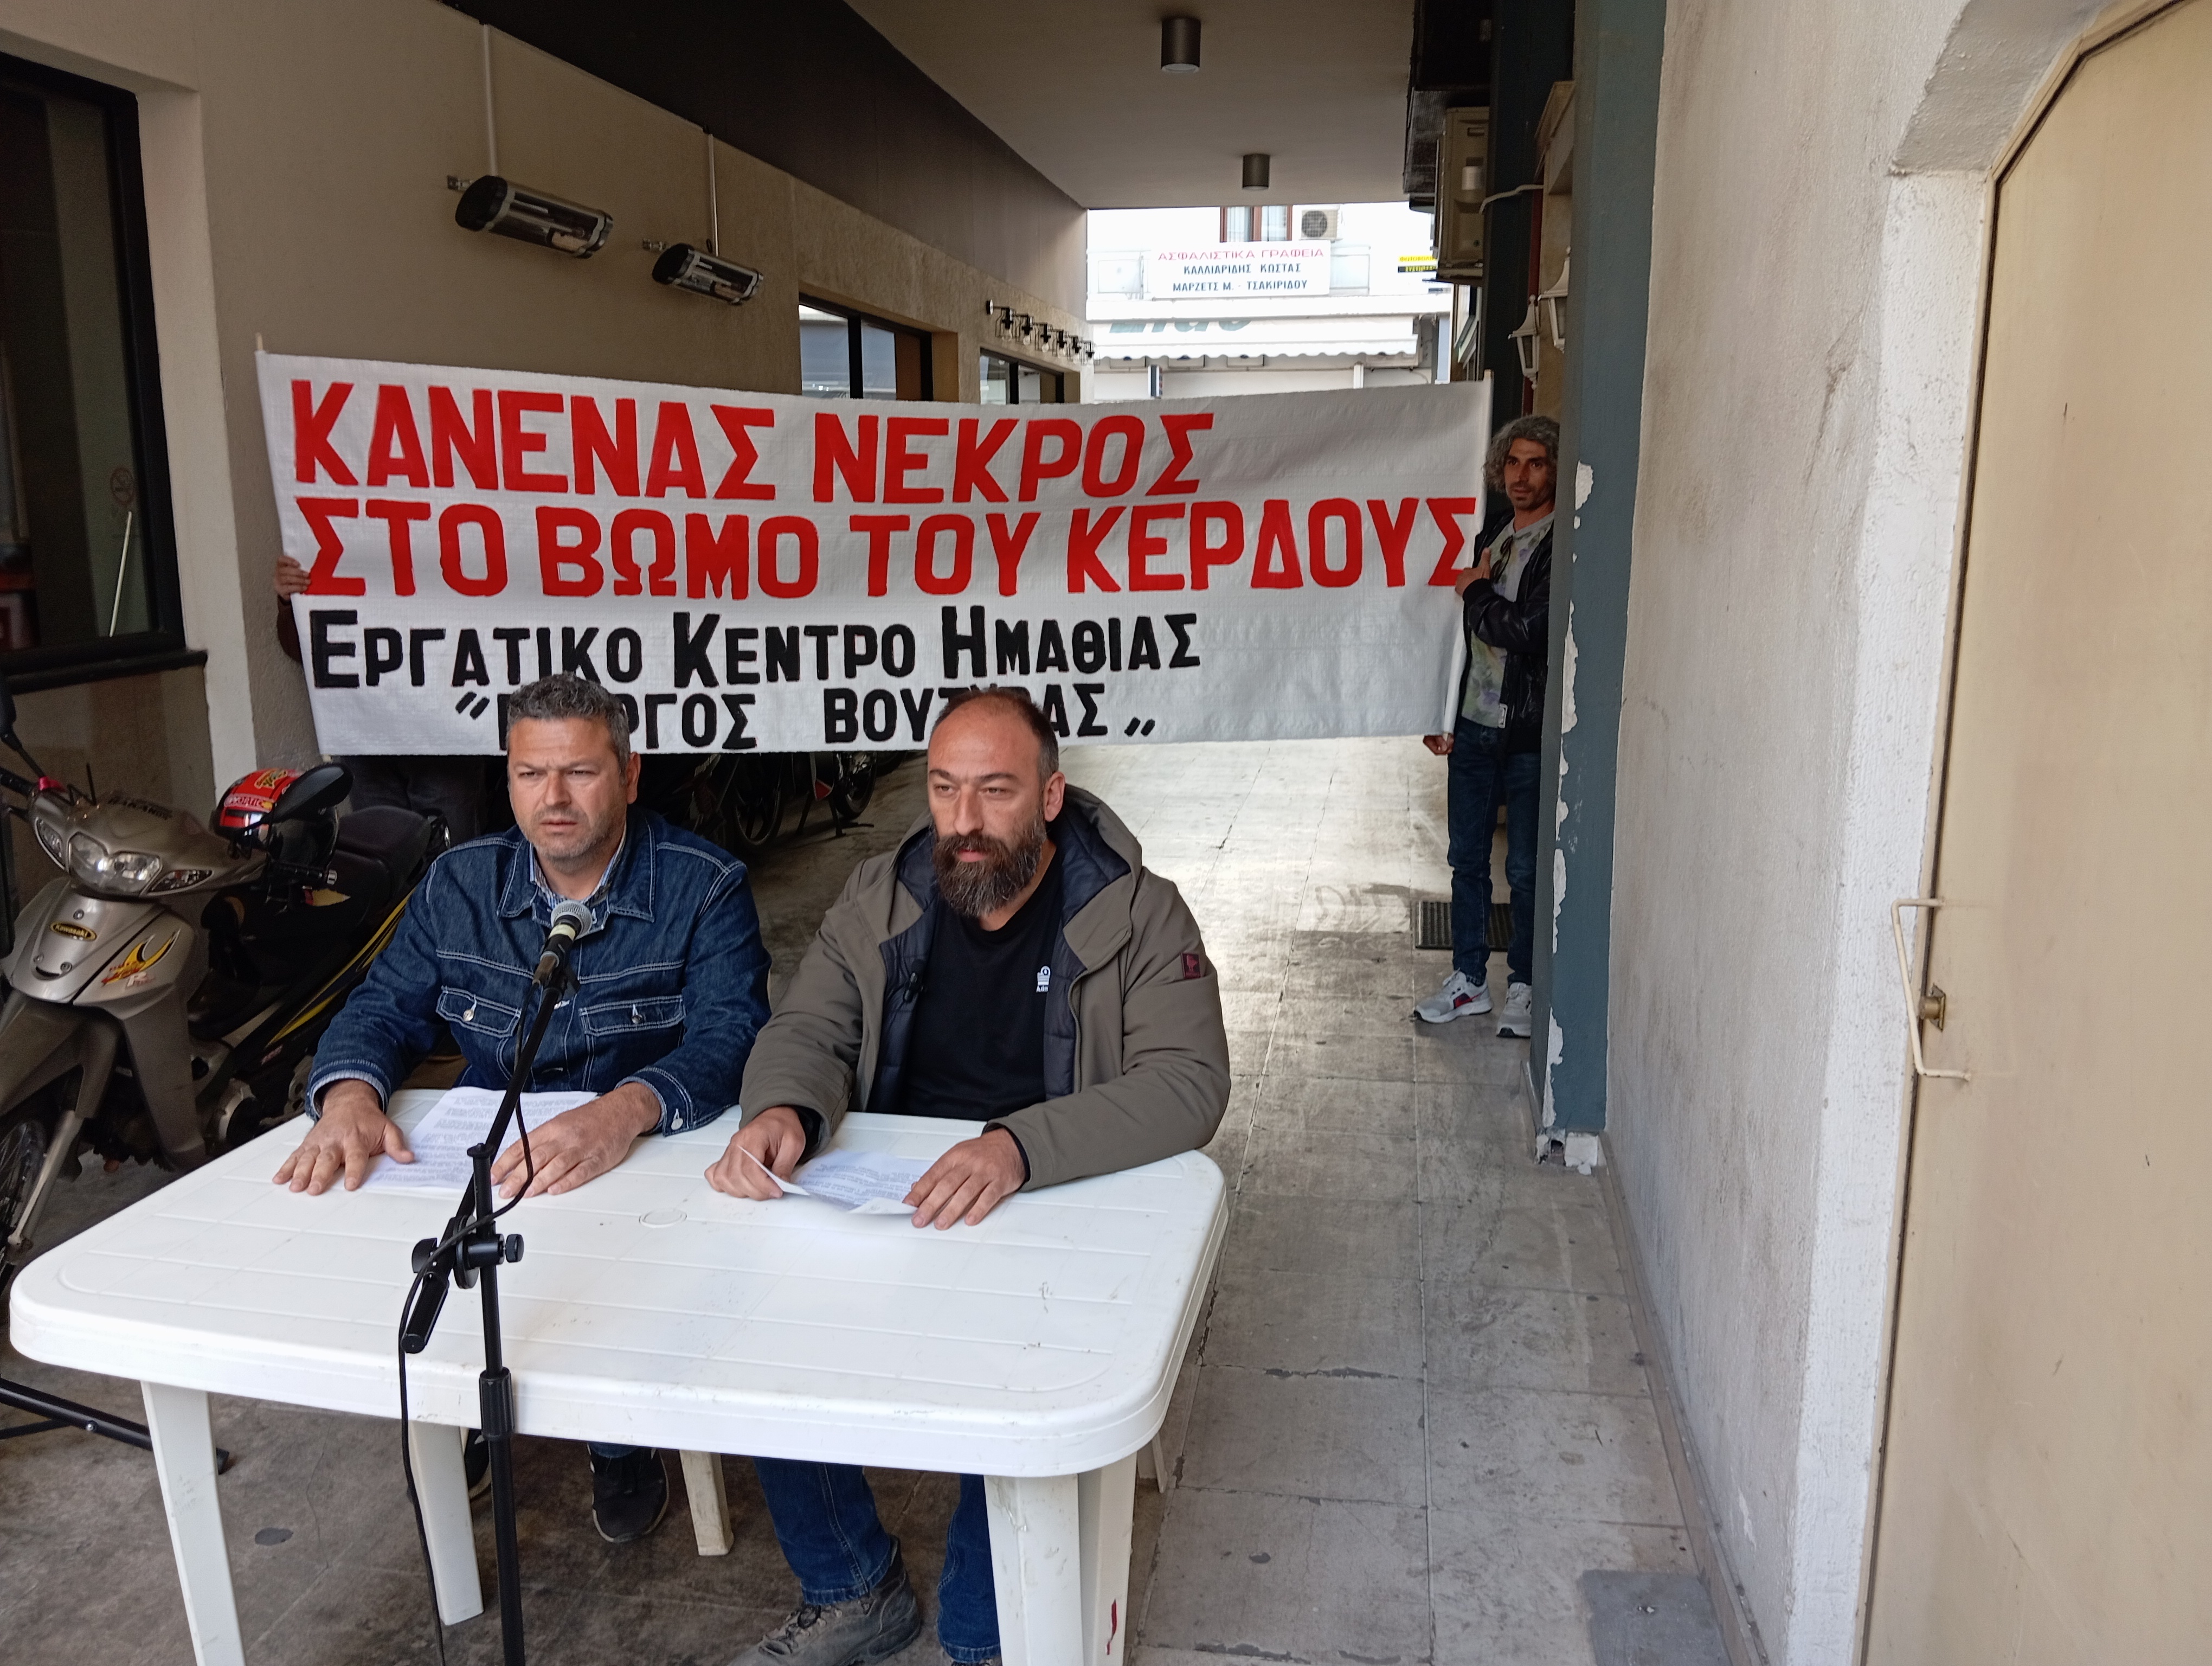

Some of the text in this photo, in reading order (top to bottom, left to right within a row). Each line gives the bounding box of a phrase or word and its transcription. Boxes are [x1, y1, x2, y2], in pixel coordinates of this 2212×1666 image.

[1158, 248, 1324, 261] ΑΣΦΑΛΙΣΤΙΚΑ ΓΡΑΦΕΙΑ
[1184, 262, 1301, 275] ΚΑΛΛΙΑΡΙΔΗΣ ΚΩΣΤΑΣ
[1173, 282, 1219, 292] ΜΑΡΖΕΤΣ
[1247, 280, 1308, 291] ΤΣΑΚΙΡΙΔΟΥ
[292, 380, 1213, 504] ΚΑΝΕΝΑΣ ΝΕΚΡΟΣ
[296, 497, 1477, 600] ΣΤΟ ΒΩΜΟ ΤΟΥ ΚΕΡΔΟΥΣ
[309, 605, 1201, 689] ΕΡΓΑΤΙΚΟ ΚΕΝΤΡΟ ΗΜΑΘΙΑΣ
[55, 924, 89, 938] Kawasaki
